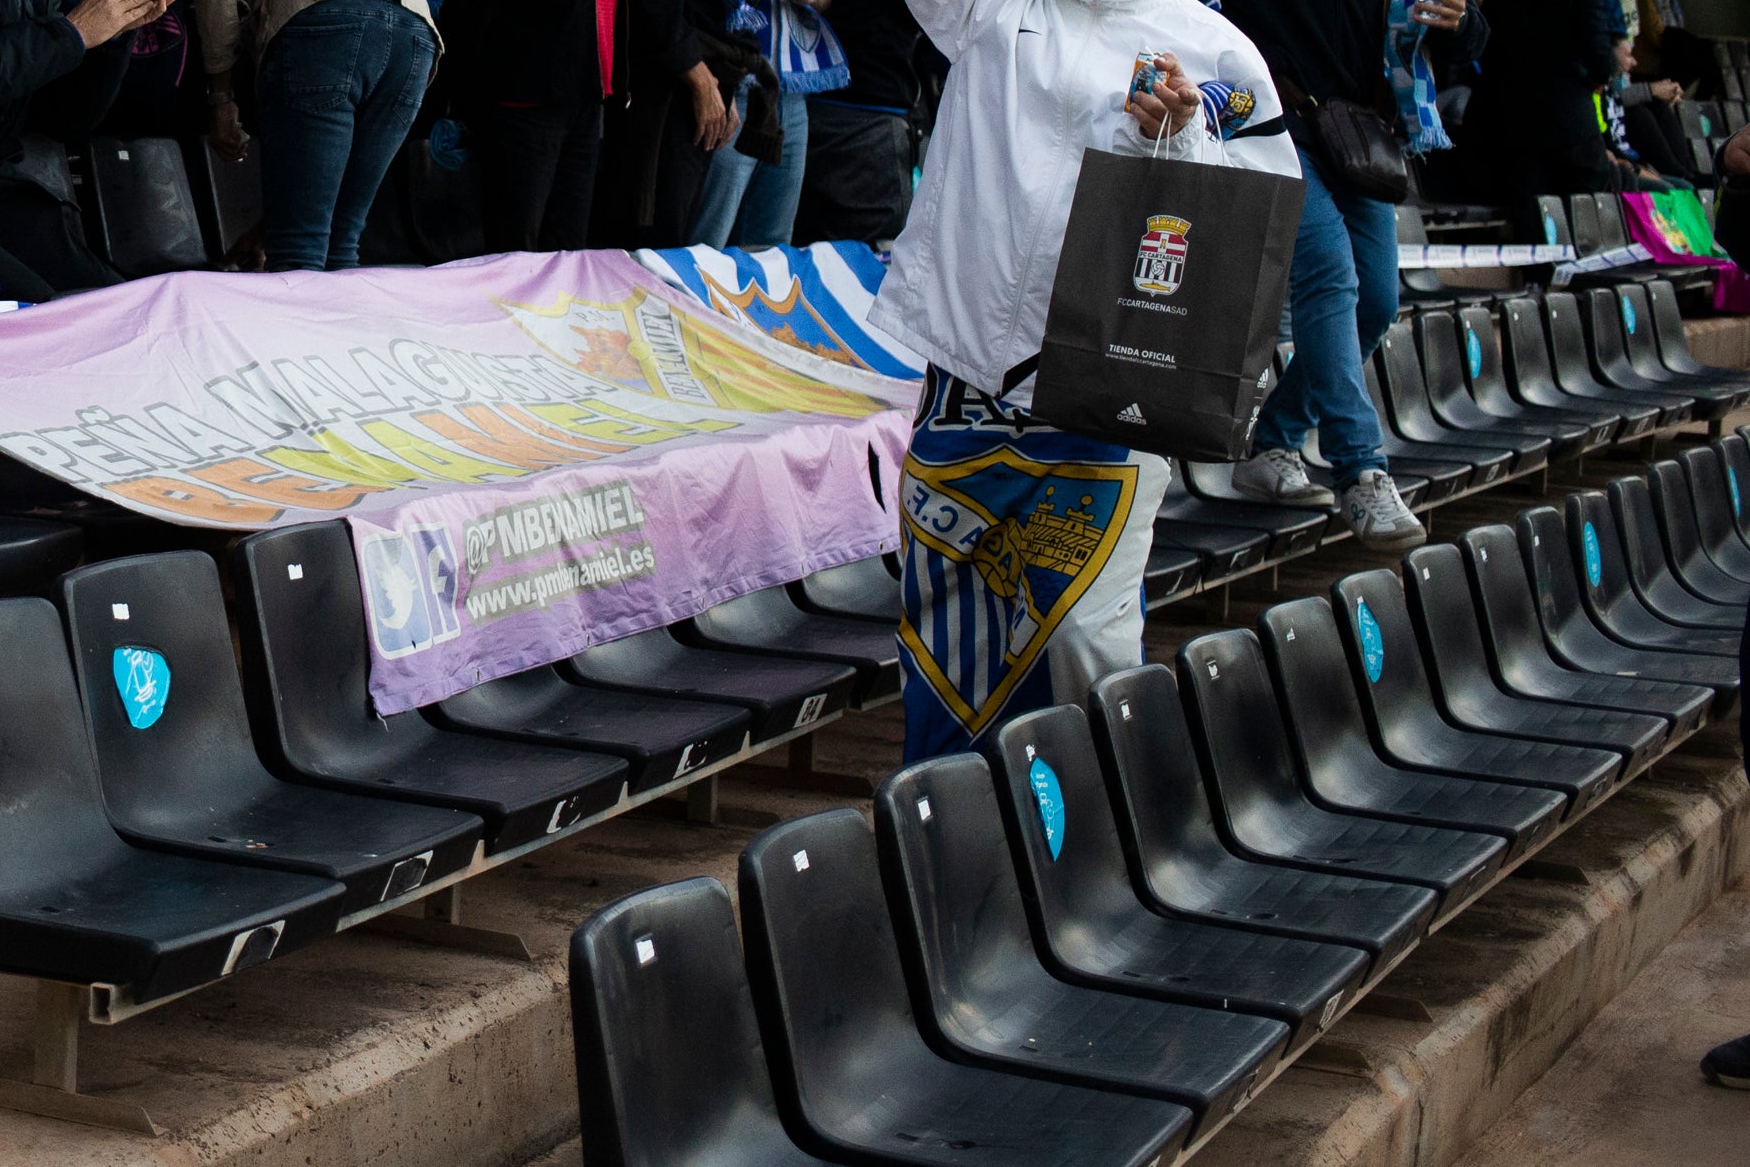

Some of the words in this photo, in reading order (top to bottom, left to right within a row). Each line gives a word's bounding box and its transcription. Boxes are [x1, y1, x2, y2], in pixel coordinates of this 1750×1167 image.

[1147, 252, 1183, 263] CARTAGENA
[1117, 297, 1188, 316] FCCARTAGENASAD
[1109, 344, 1140, 358] TIENDA
[1141, 350, 1176, 364] OFICIAL
[203, 337, 620, 437] MALAGUISTA
[1116, 412, 1147, 426] adidas
